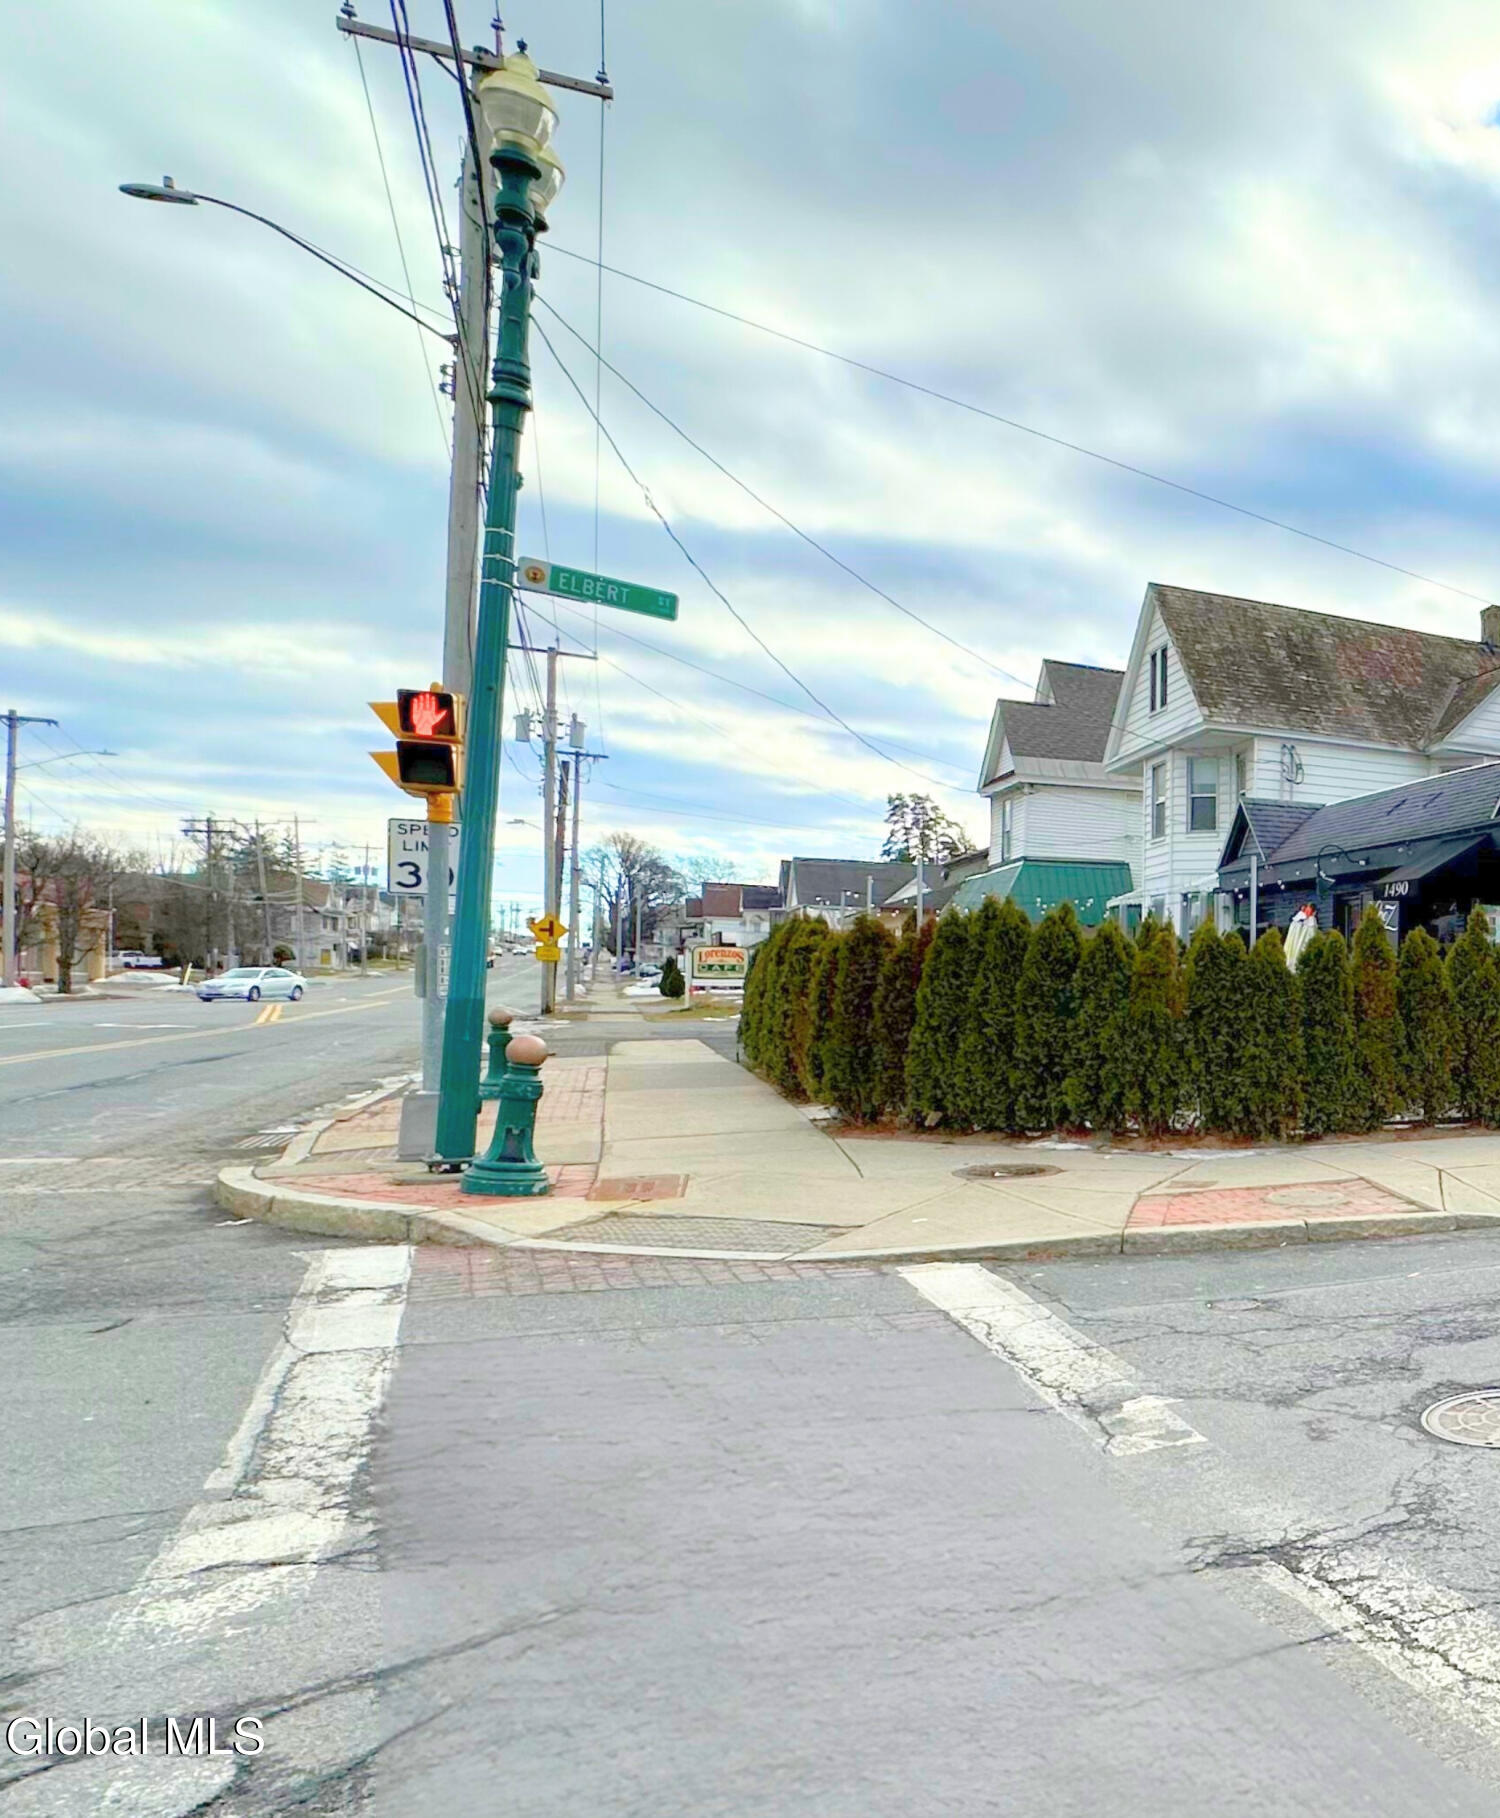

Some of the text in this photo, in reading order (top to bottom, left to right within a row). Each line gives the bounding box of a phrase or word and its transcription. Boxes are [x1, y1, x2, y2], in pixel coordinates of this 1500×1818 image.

[559, 573, 630, 603] ELBERT
[397, 823, 459, 838] SPED
[396, 861, 454, 889] 3
[1384, 881, 1409, 898] 1490
